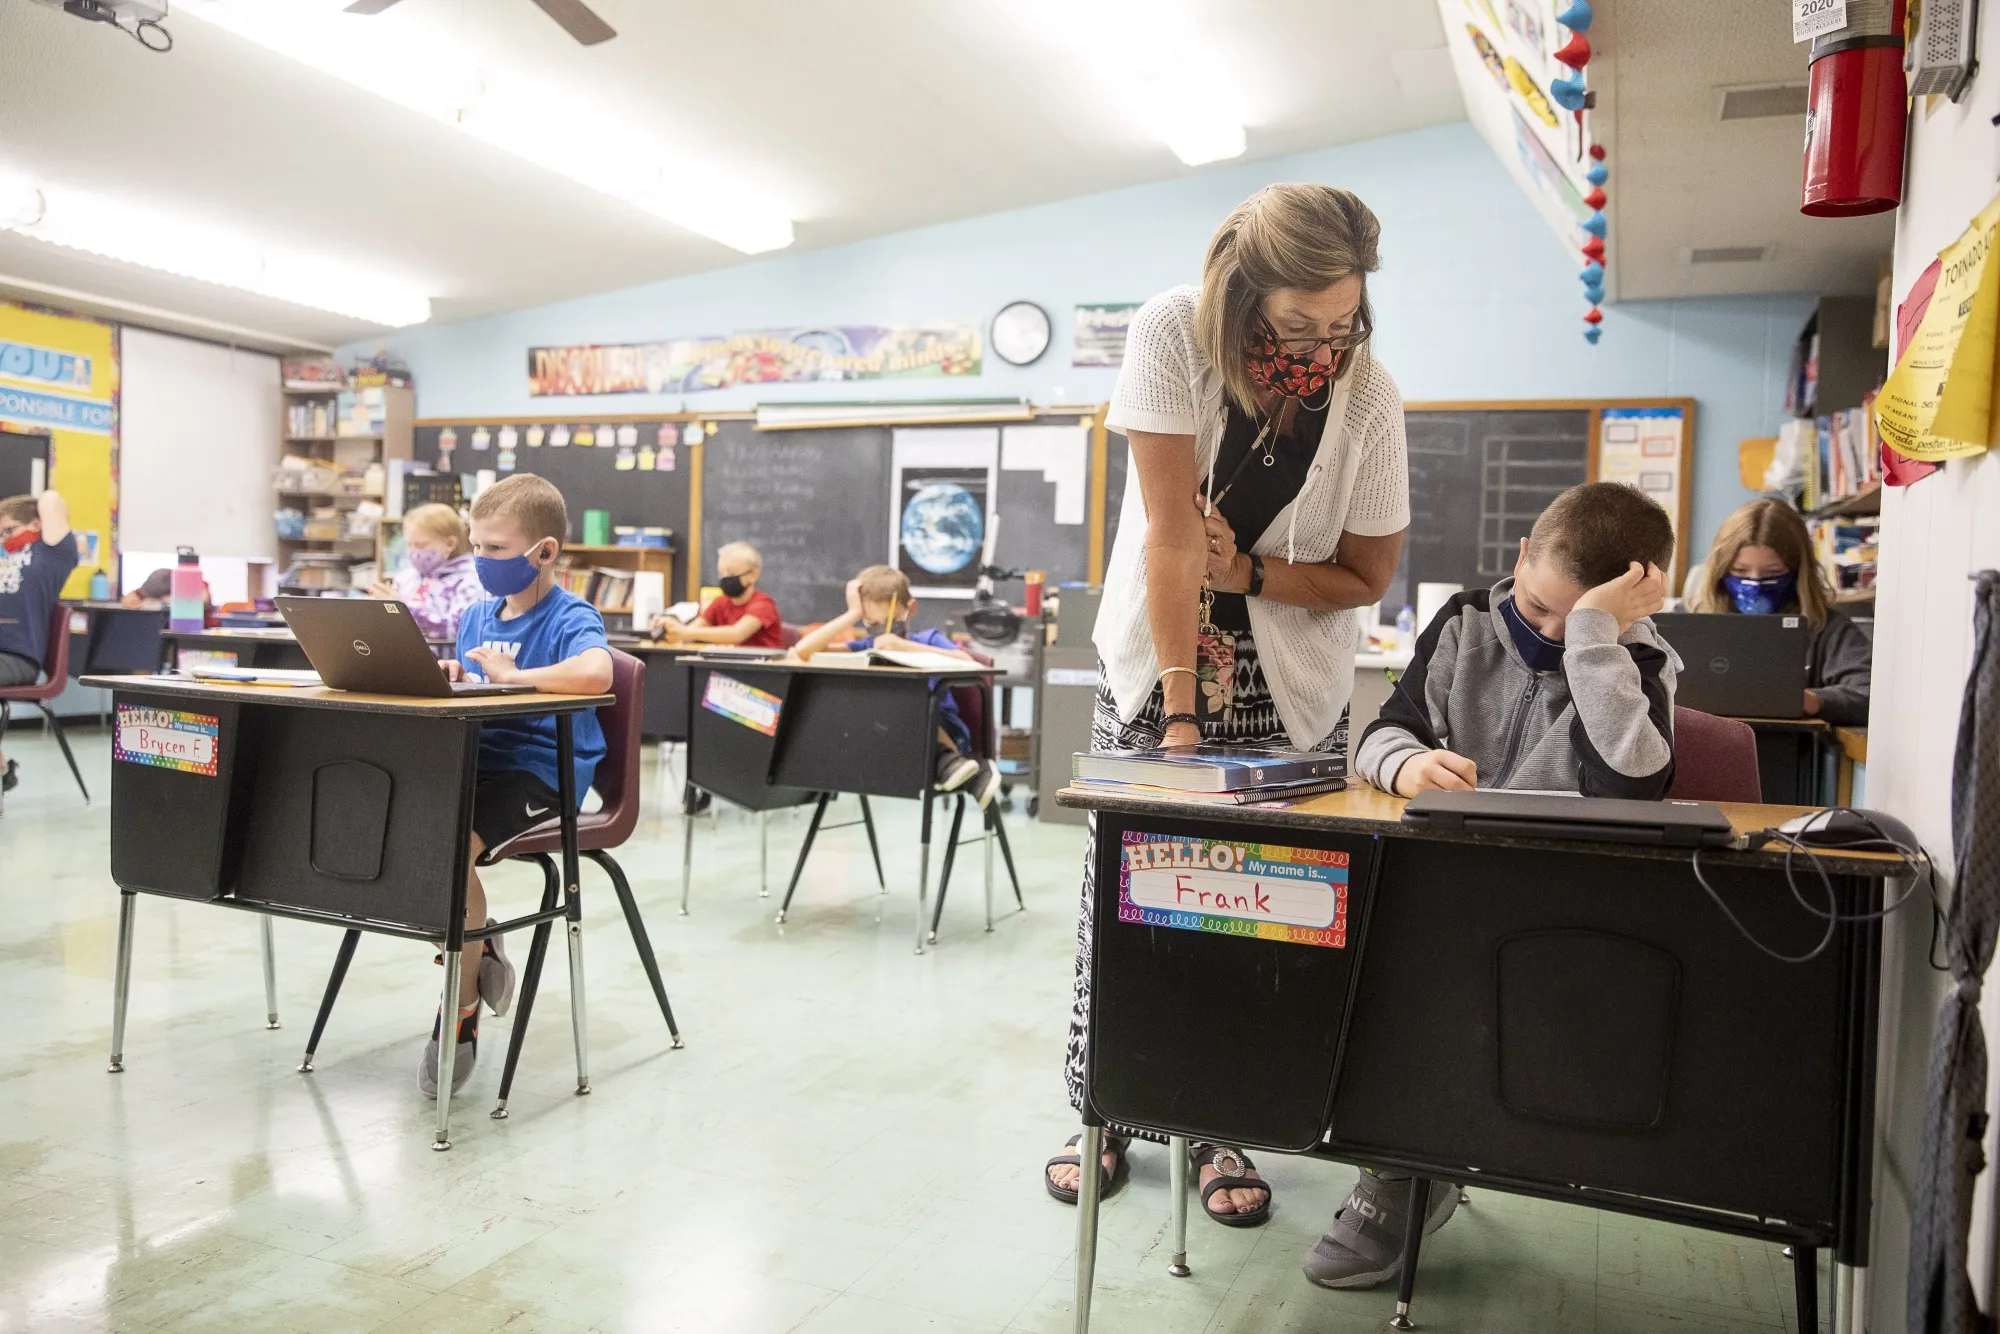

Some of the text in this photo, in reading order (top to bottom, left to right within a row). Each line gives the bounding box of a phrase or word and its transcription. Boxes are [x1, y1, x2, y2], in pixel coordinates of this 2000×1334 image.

[1801, 0, 1834, 17] 2020
[1944, 240, 1983, 287] TORNADO
[1890, 394, 1918, 408] SIGNAL
[1891, 407, 1918, 421] MEANS
[118, 709, 174, 729] HELLO!
[174, 721, 183, 731] My
[184, 724, 199, 732] name
[140, 728, 202, 758] Brycen F.
[1125, 842, 1246, 873] HELLO!
[1248, 860, 1267, 876] My
[1270, 866, 1304, 877] name
[1175, 875, 1271, 913] Frank
